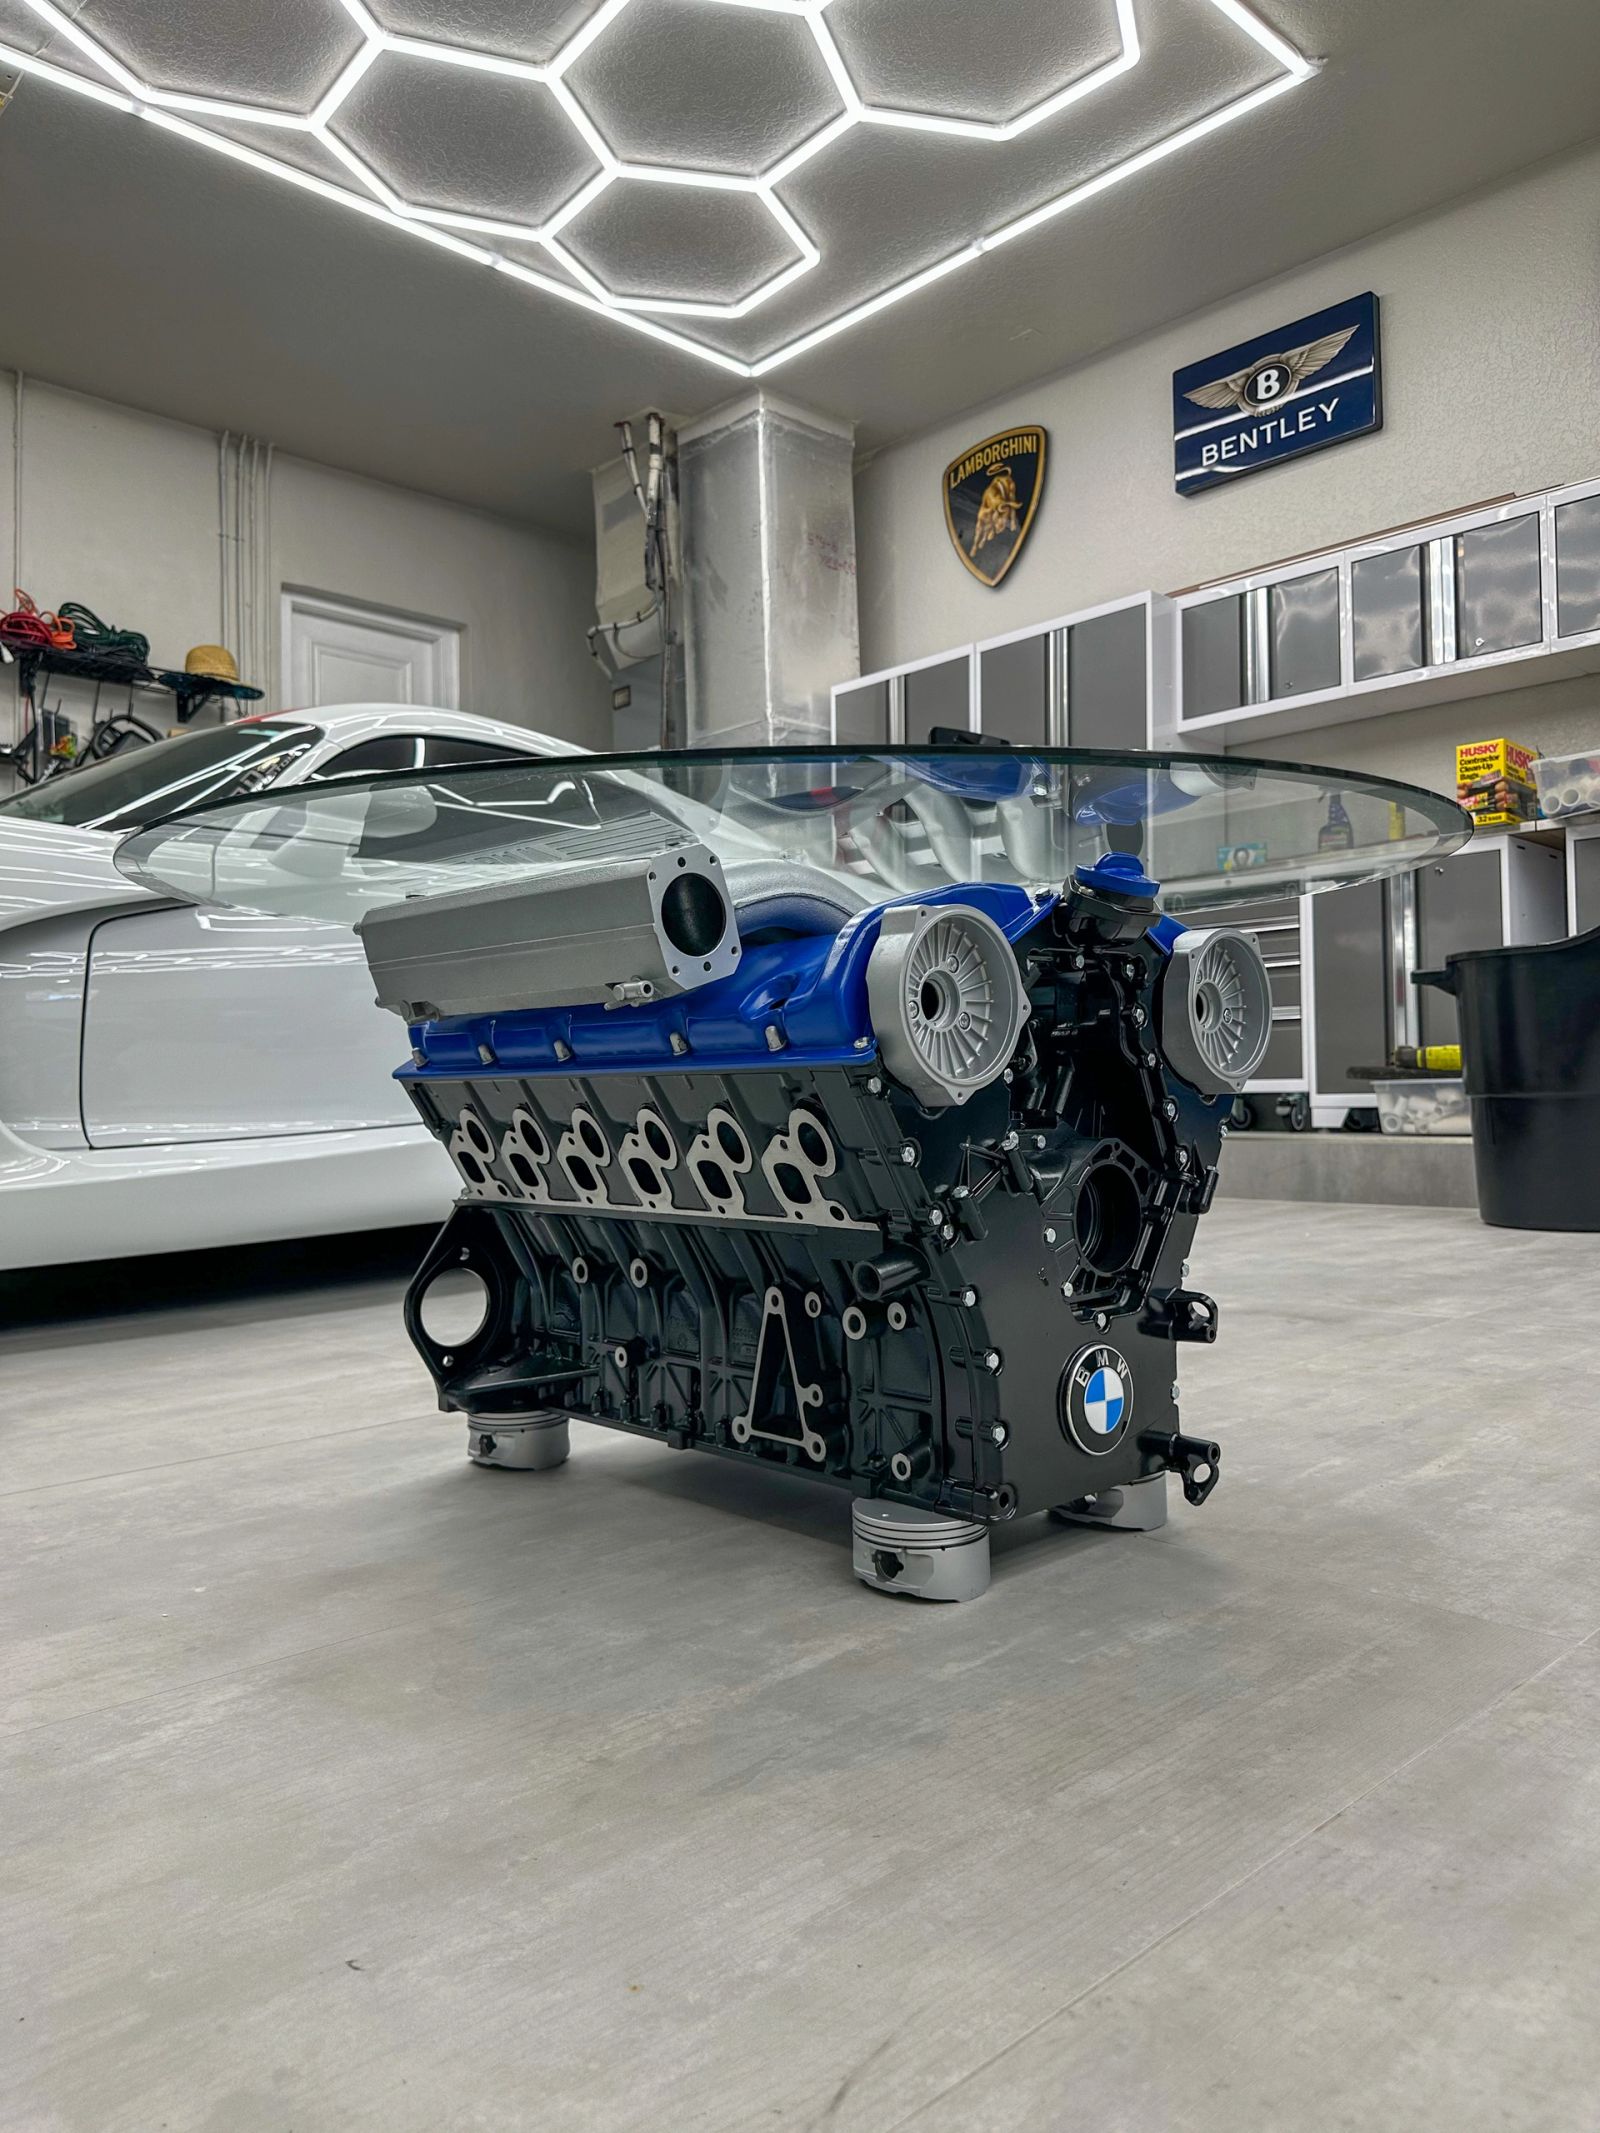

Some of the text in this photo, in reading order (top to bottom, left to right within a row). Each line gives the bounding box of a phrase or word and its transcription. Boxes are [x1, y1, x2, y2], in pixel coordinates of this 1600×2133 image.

[1256, 368, 1280, 400] B
[1201, 397, 1339, 467] BENTLEY
[950, 435, 1037, 489] LAMBORGHINI
[1460, 743, 1499, 758] HUSKY
[1460, 755, 1500, 766] Contractor
[1460, 763, 1494, 773] Clean-Up
[1075, 1349, 1128, 1388] BMW
